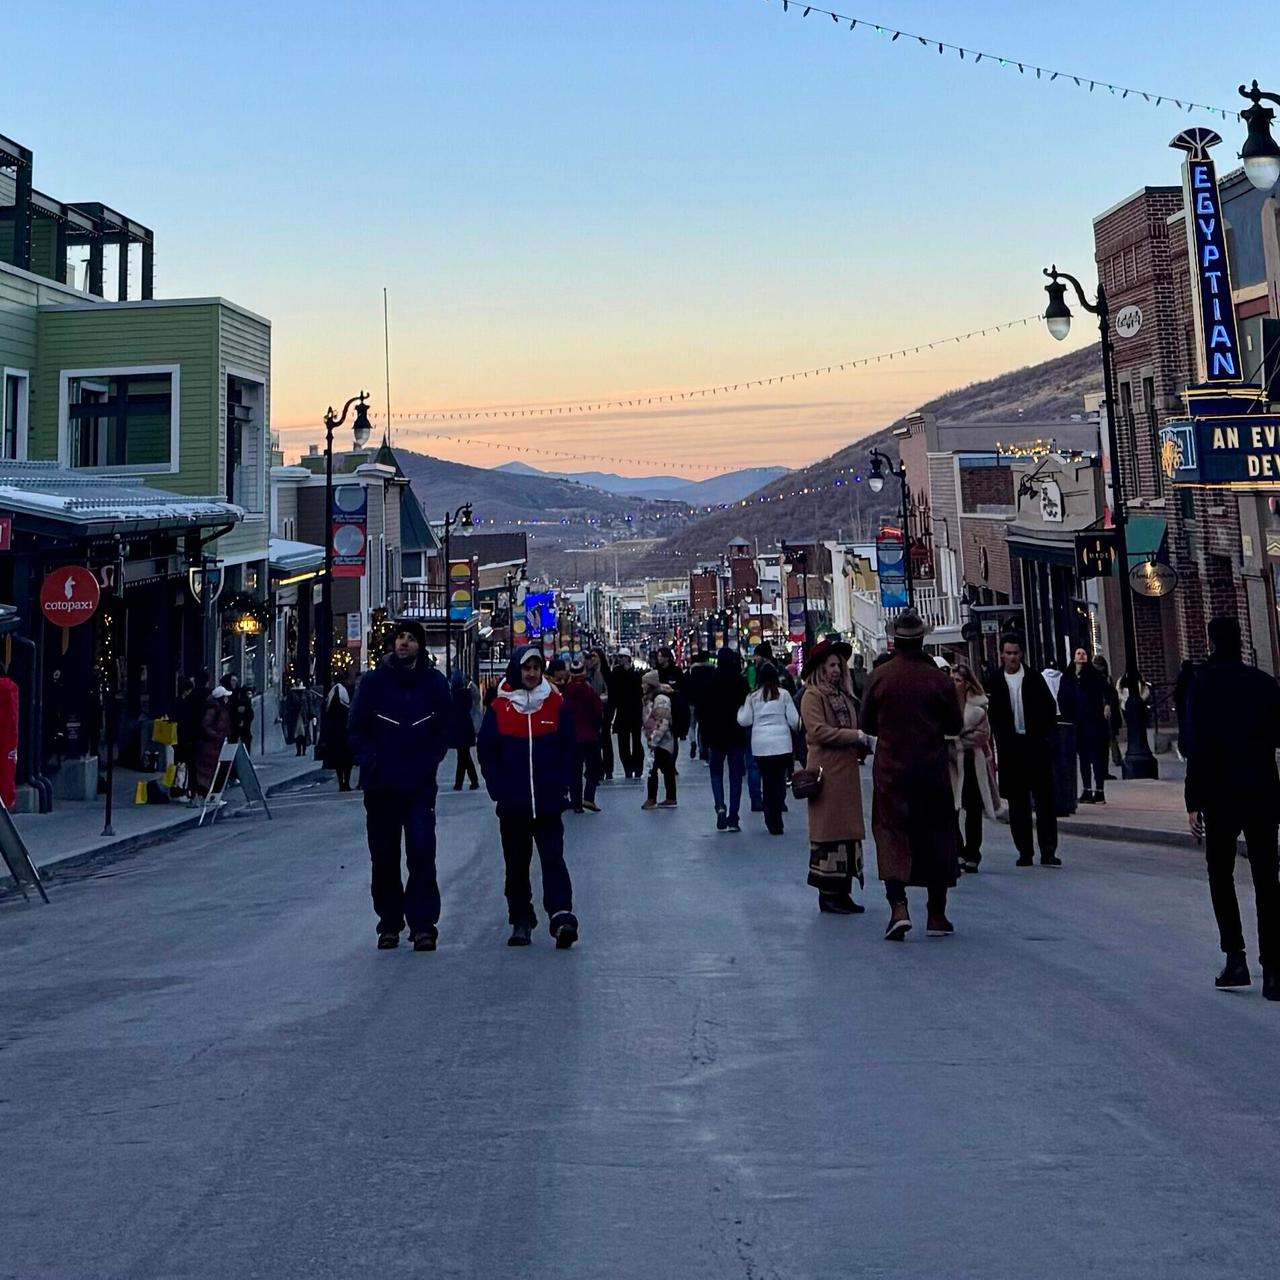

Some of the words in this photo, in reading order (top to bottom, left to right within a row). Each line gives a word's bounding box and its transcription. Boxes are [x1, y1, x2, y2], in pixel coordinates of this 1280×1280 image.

[1194, 166, 1235, 375] EGYPTIAN
[1212, 426, 1239, 449] AN
[44, 601, 93, 612] cotopaxi
